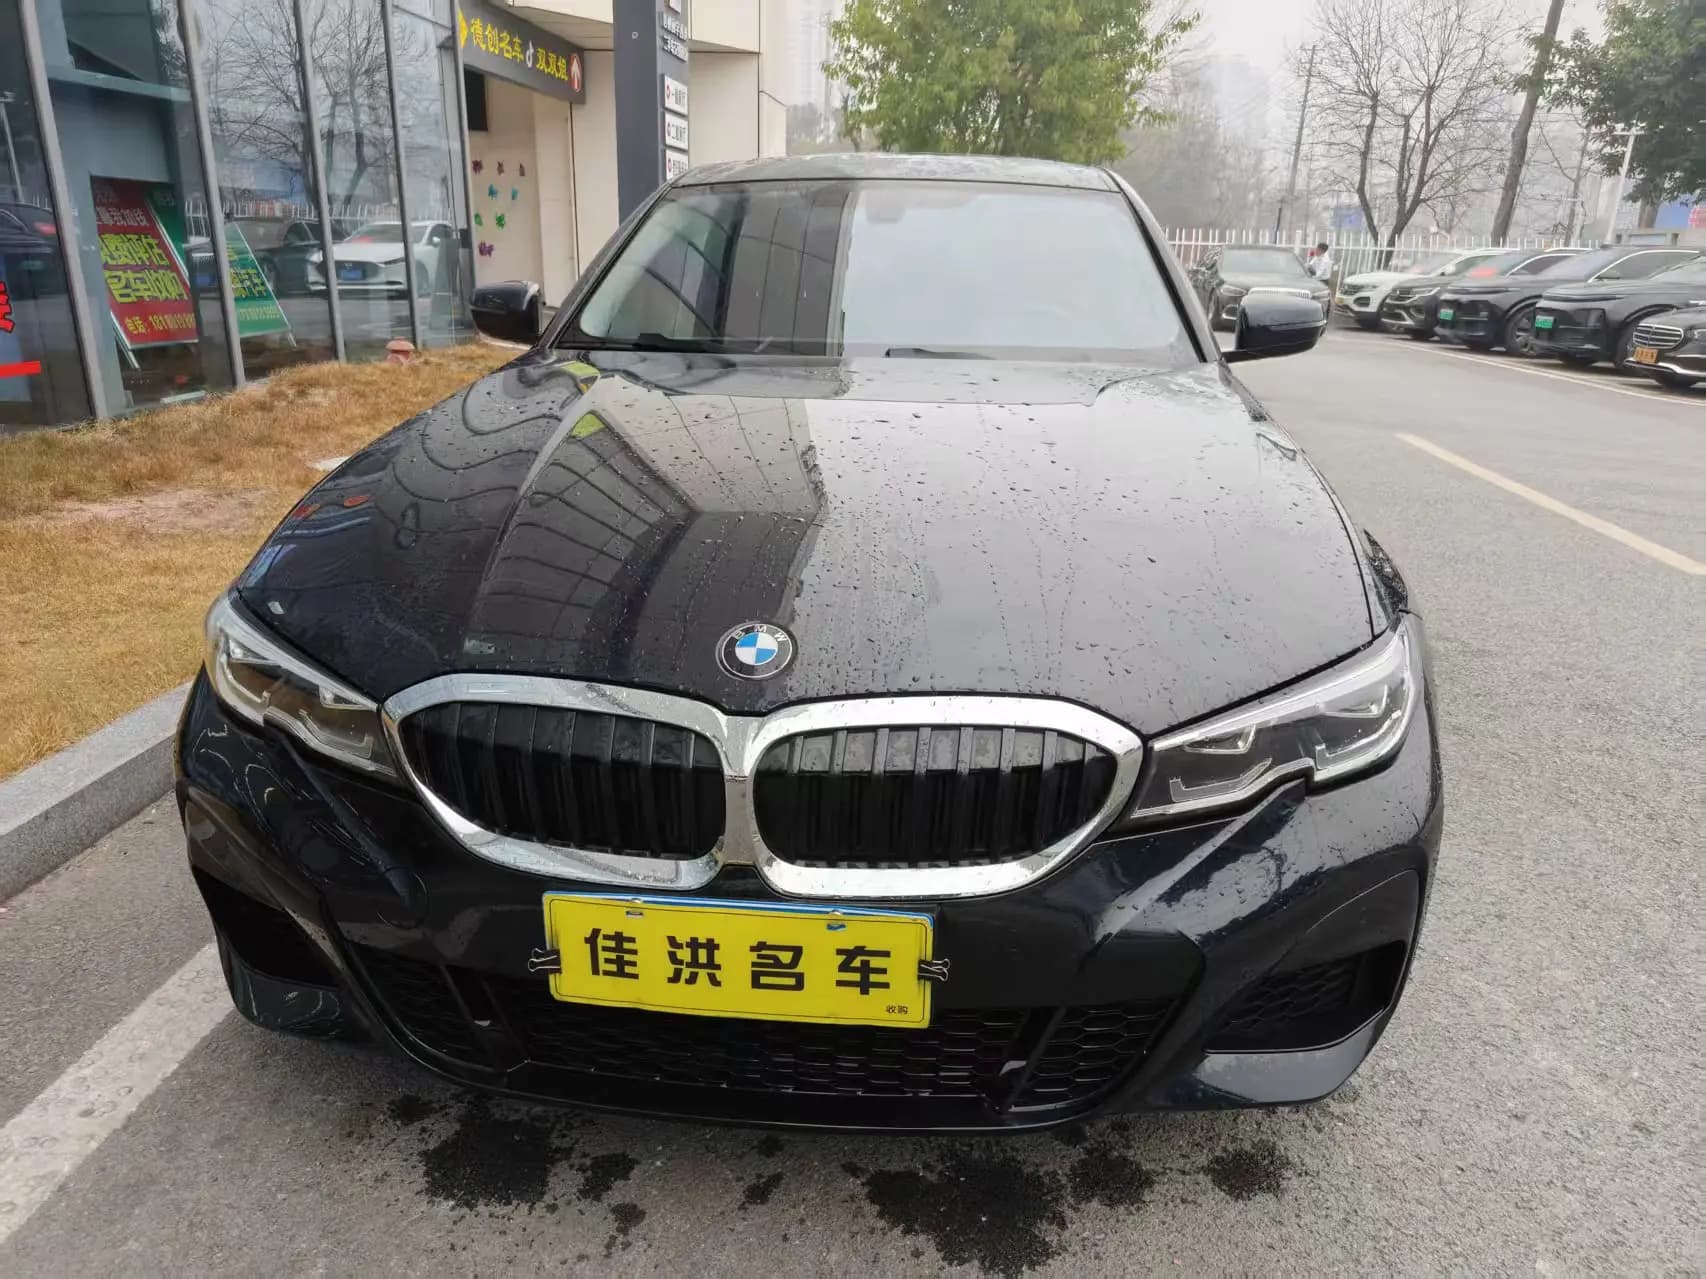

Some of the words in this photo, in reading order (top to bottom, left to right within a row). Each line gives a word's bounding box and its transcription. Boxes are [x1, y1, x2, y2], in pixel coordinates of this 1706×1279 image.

[470, 17, 525, 64] 德创名车
[104, 269, 189, 303] 名车收购
[730, 623, 788, 642] BMW
[583, 927, 892, 996] 佳洪名车
